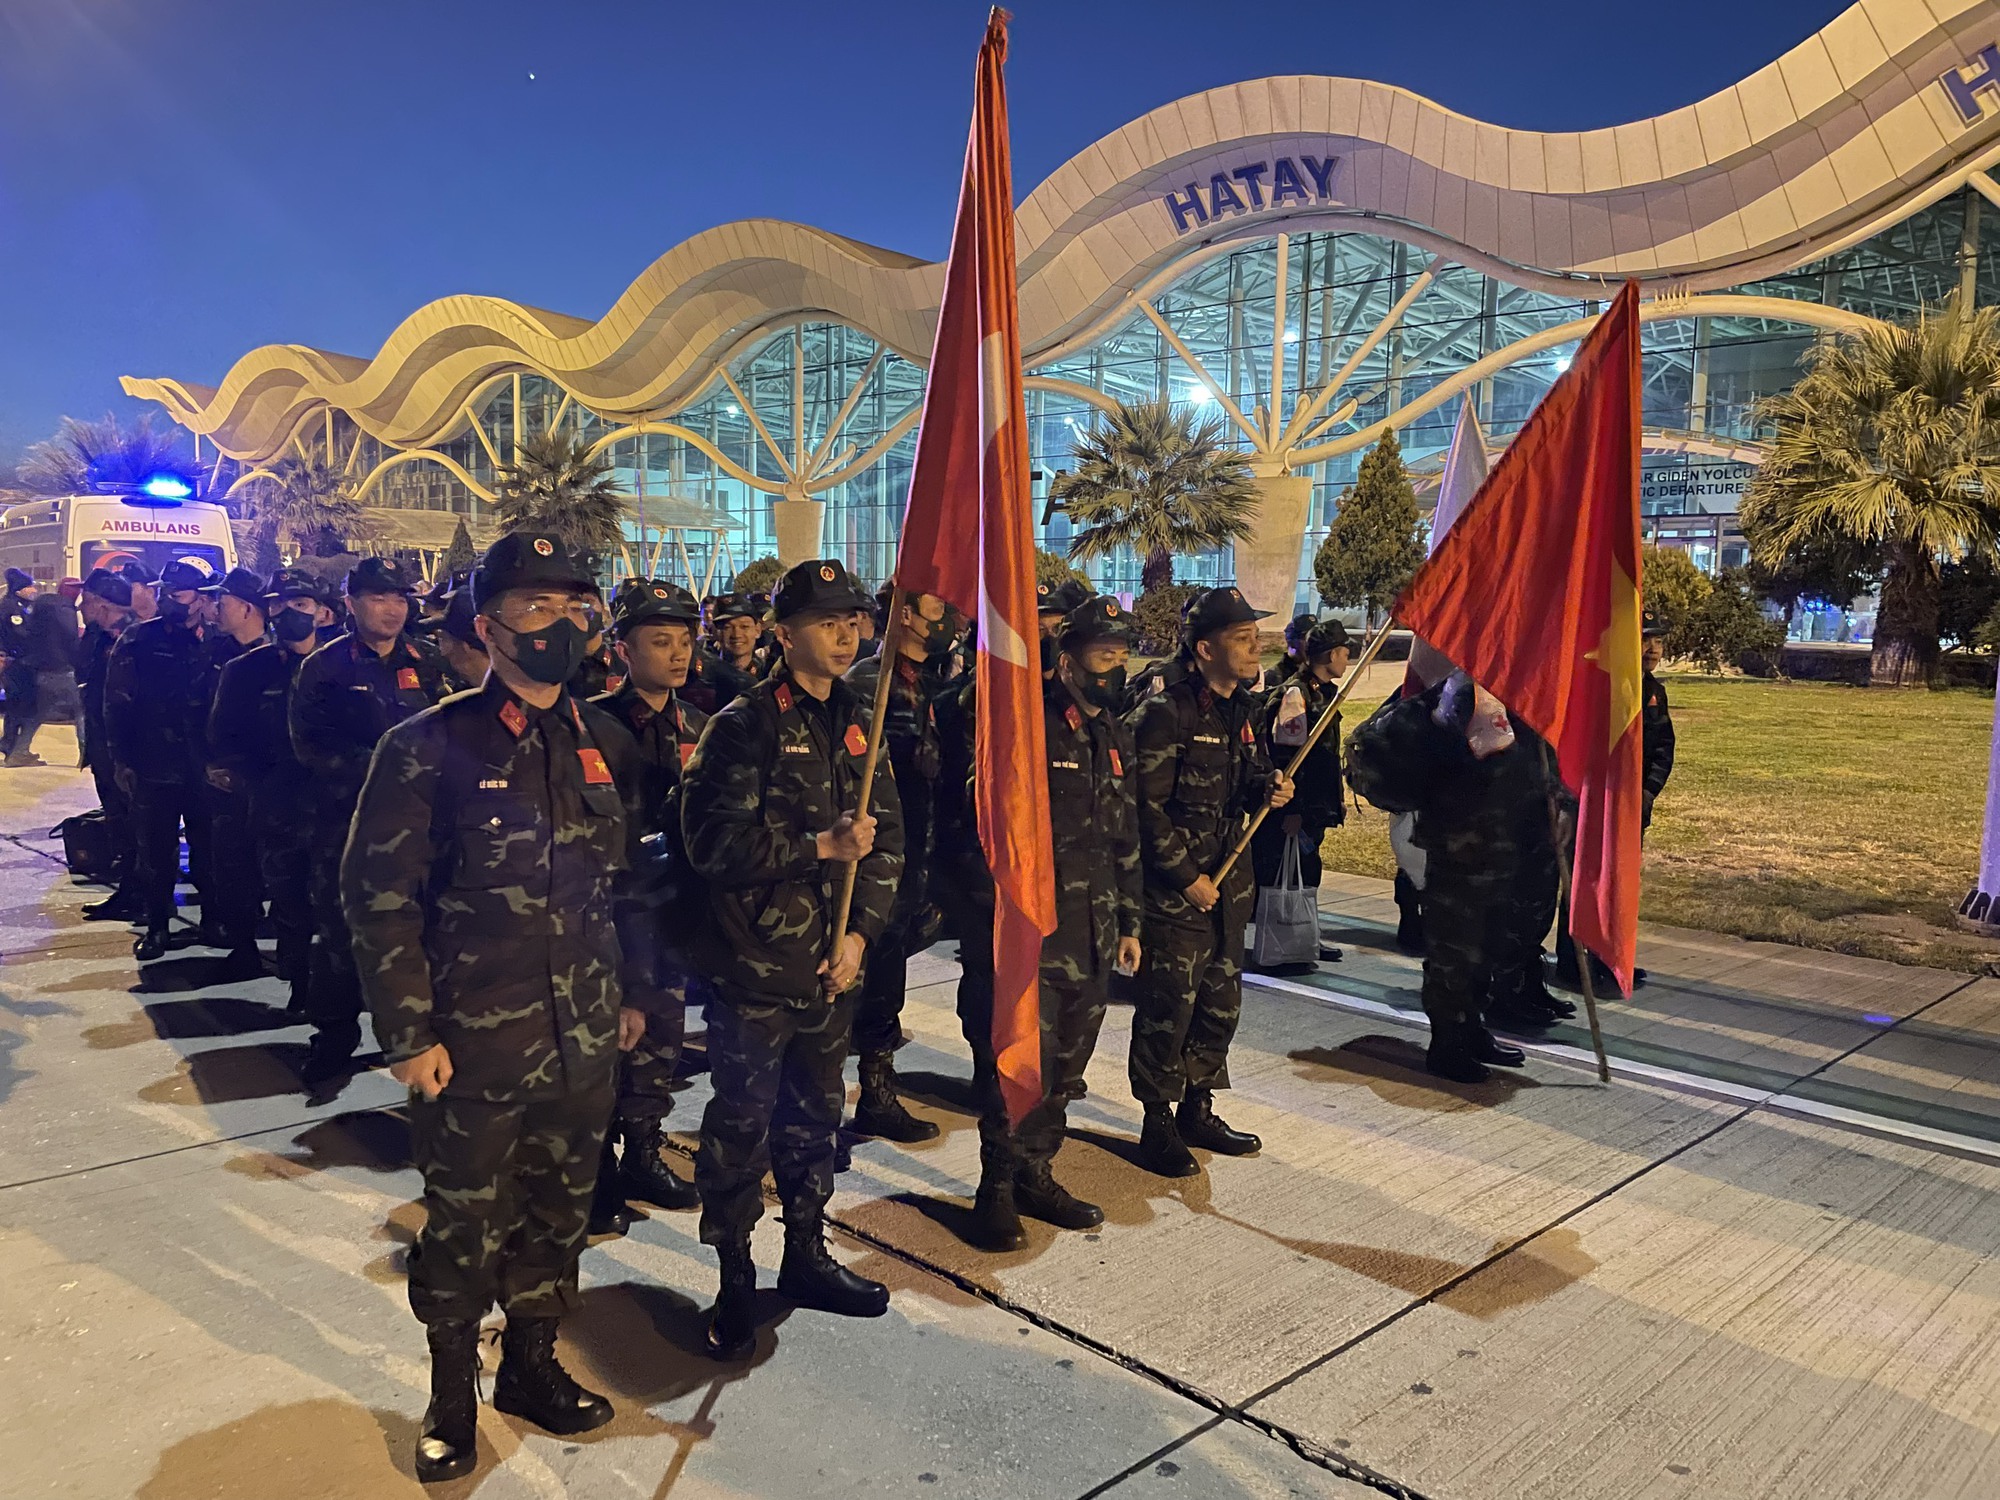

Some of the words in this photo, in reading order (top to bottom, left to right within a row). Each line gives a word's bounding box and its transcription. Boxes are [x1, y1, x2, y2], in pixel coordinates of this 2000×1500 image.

[1163, 156, 1340, 235] HATAY
[1640, 472, 1653, 483] R
[1660, 483, 1753, 497] DEPARTURES
[101, 520, 201, 535] AMBULANS
